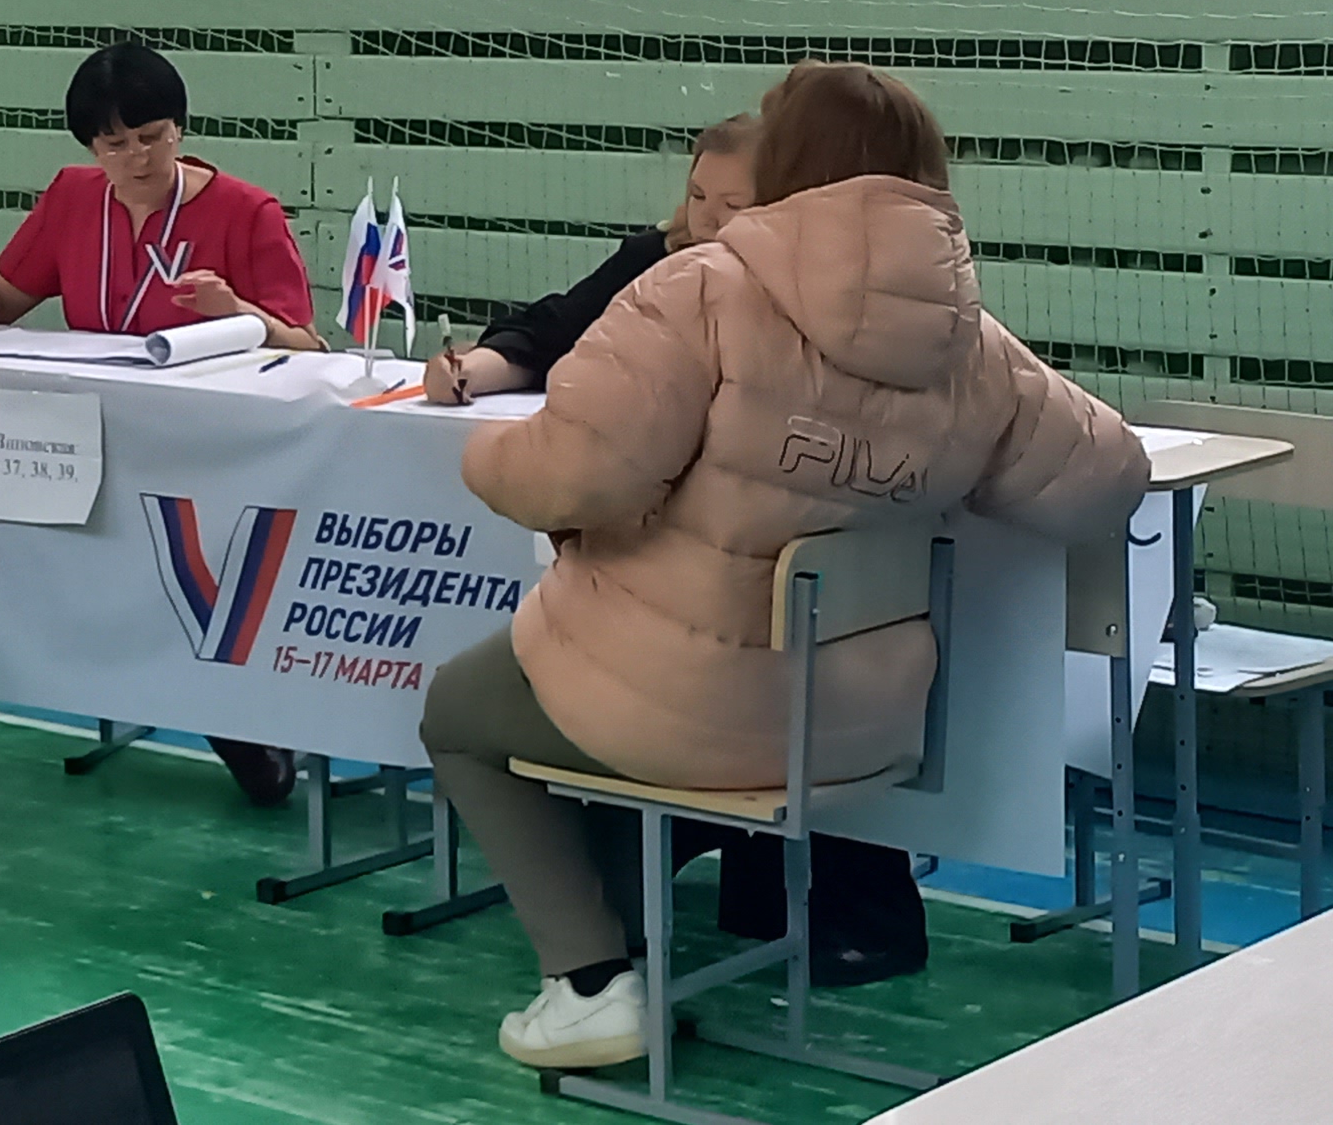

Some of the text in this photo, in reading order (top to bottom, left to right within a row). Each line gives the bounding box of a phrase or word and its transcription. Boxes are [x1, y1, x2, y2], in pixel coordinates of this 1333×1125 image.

[315, 512, 472, 557] ВЫБОРЫ
[298, 557, 523, 613] ПРЕЗИДЕНТА
[283, 602, 422, 649] РОССИИ
[334, 658, 424, 691] МАРТА
